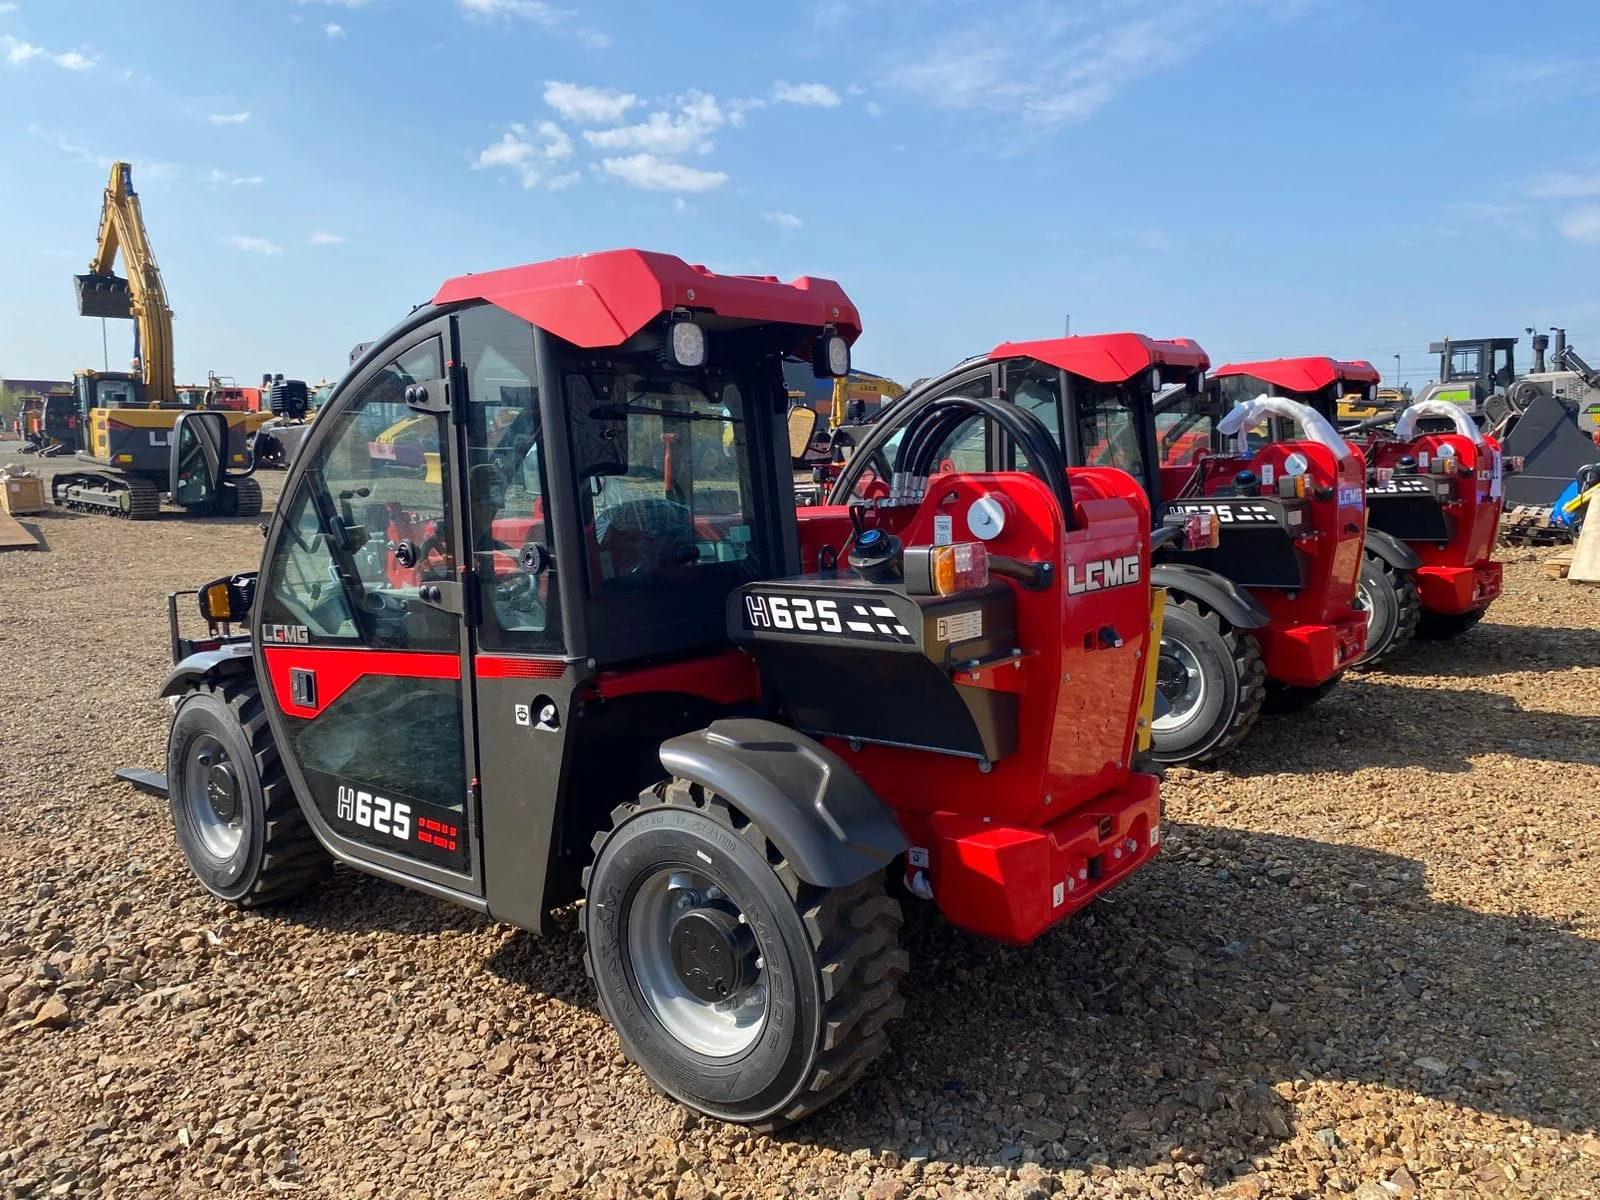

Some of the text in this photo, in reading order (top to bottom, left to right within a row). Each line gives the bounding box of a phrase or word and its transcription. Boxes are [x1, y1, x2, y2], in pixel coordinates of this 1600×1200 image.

[1068, 554, 1140, 595] LGMG
[262, 624, 309, 643] LGMG
[745, 596, 842, 633] H625
[337, 785, 411, 840] H625
